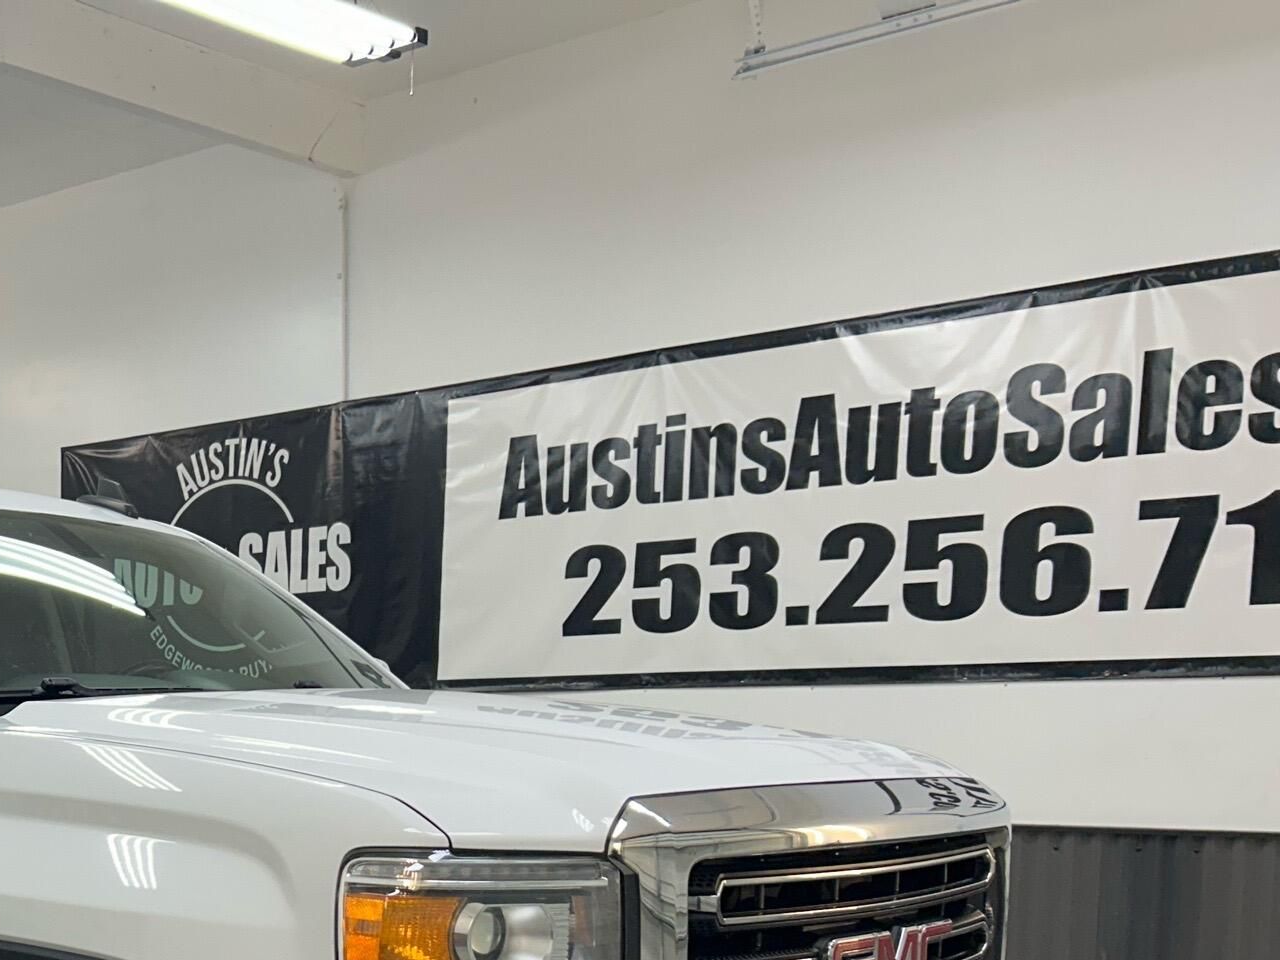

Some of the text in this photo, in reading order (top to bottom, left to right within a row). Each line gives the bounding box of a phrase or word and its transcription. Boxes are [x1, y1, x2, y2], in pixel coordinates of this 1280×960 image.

[176, 437, 290, 501] AUSTIN'S
[498, 347, 1280, 521] AustinsAutoSales
[238, 521, 352, 594] SALES
[562, 489, 1280, 638] 253.256.71
